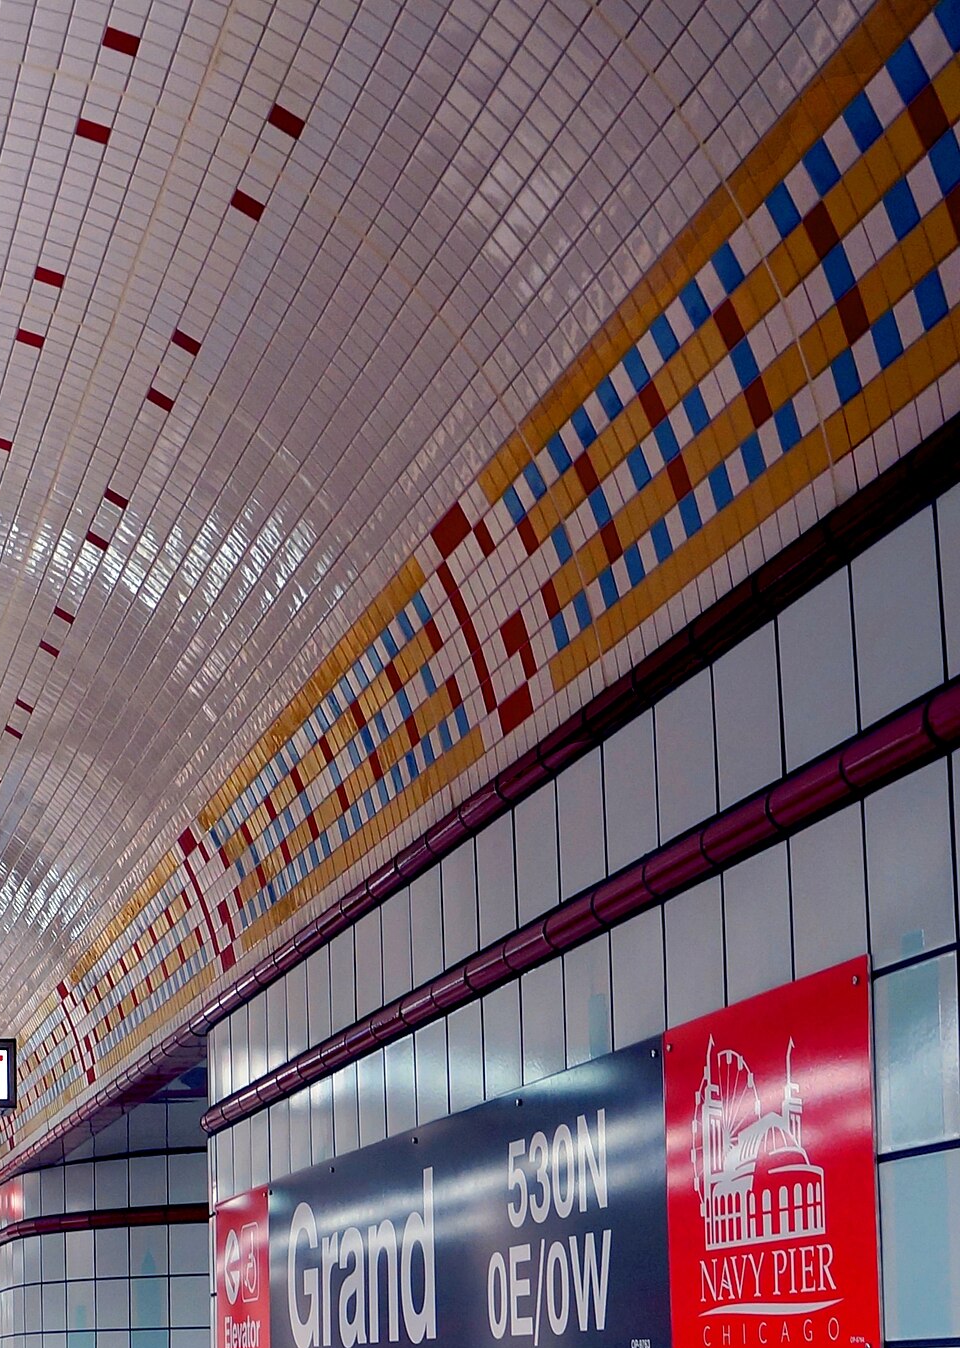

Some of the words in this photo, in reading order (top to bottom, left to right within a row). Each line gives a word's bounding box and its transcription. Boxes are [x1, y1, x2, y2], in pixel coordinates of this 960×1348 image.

[506, 1107, 609, 1229] 530N
[487, 1229, 612, 1347] 0E/0W
[699, 1251, 765, 1303] NAVY
[771, 1243, 837, 1295] PIER
[703, 1317, 840, 1347] CHICAGO
